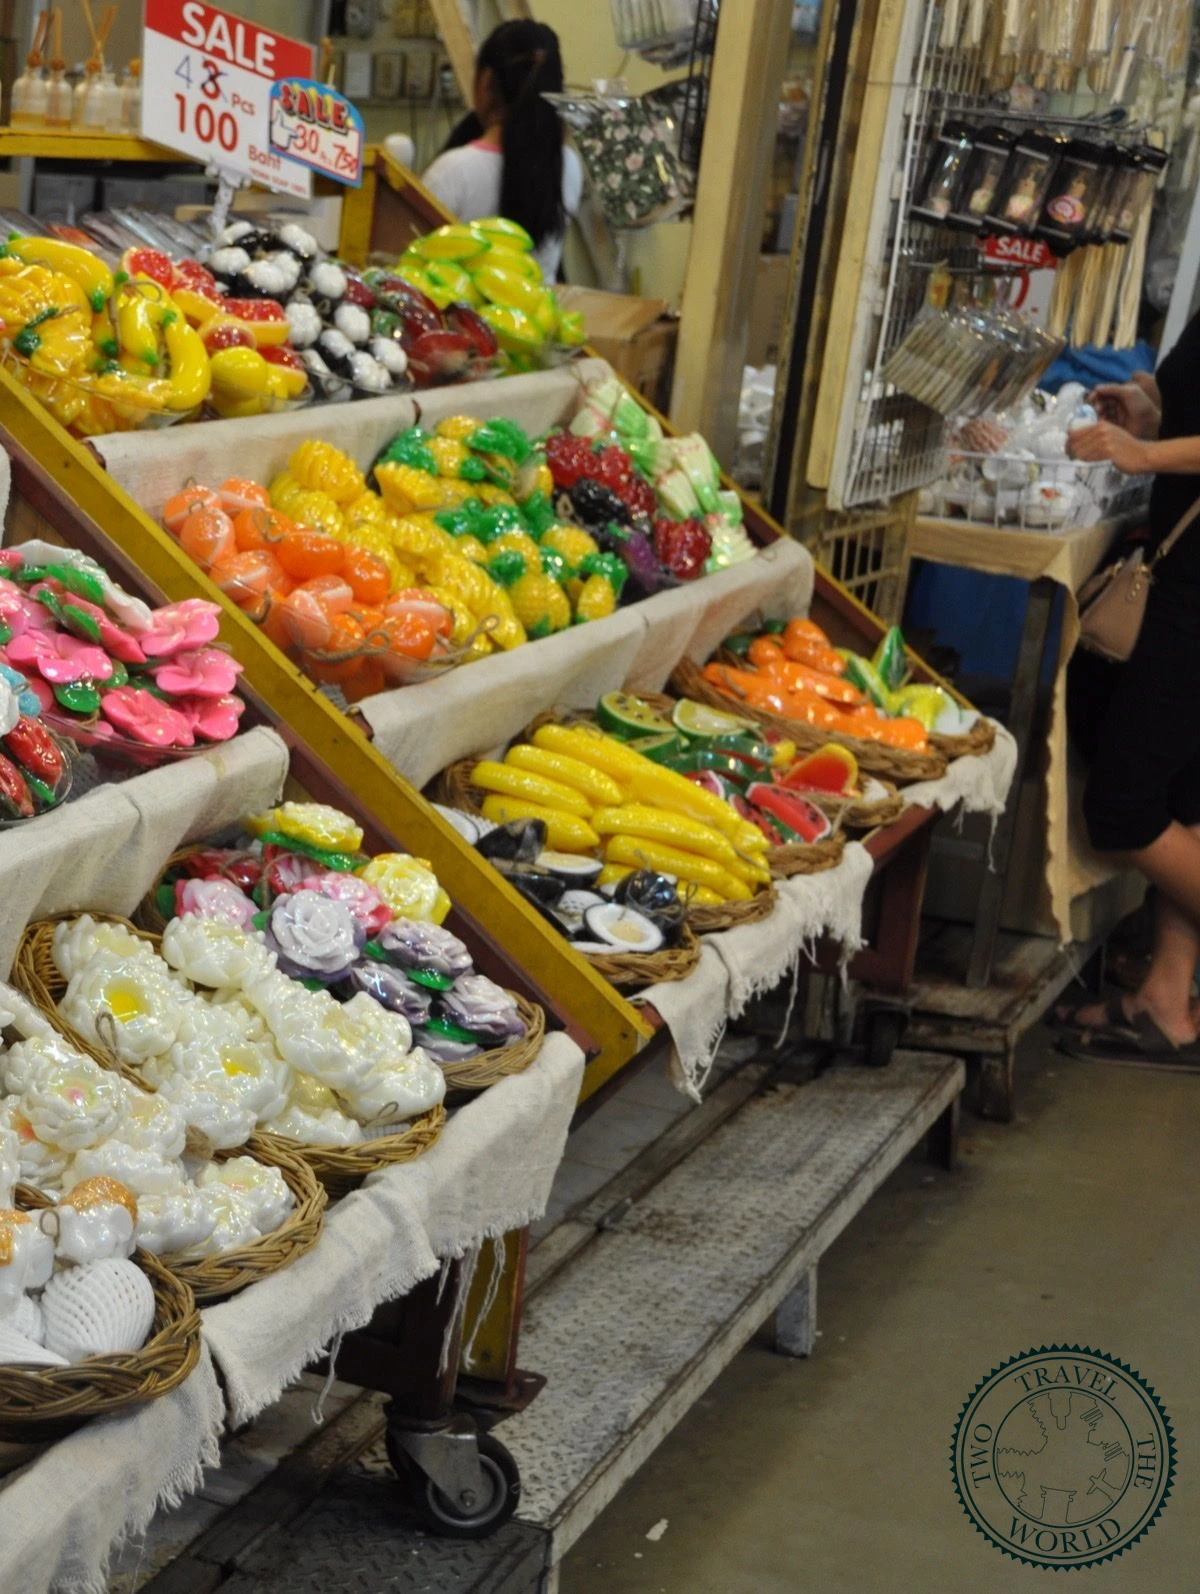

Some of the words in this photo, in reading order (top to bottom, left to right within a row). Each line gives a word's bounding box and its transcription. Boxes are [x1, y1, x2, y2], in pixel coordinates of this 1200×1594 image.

[181, 1, 276, 77] SALE
[175, 92, 238, 152] 100
[281, 83, 347, 133] SALE
[248, 144, 282, 170] Baht
[293, 124, 319, 154] 30
[995, 236, 1043, 262] SALE
